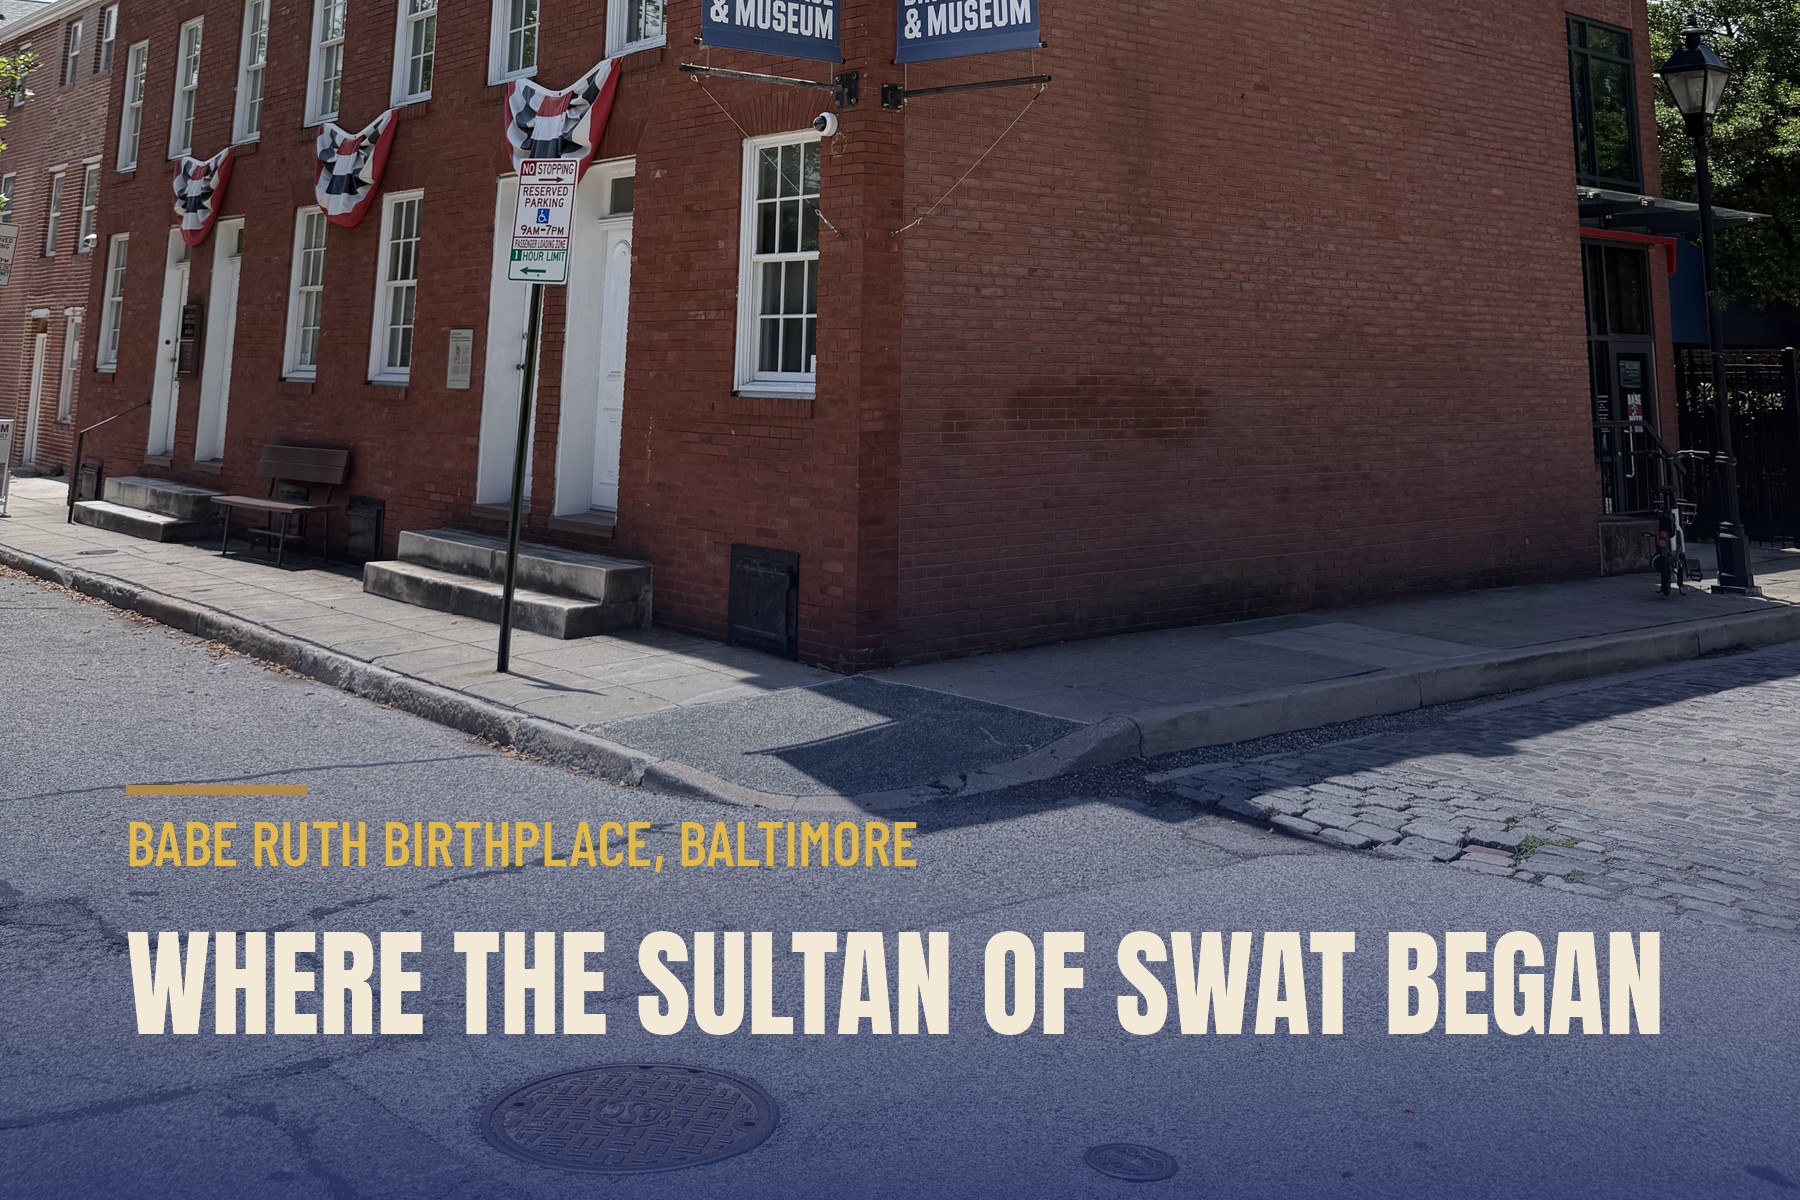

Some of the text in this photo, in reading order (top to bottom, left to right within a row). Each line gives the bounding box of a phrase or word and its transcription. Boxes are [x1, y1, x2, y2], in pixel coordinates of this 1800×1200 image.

[904, 8, 922, 39] &
[522, 163, 574, 175] NO STOPPING
[522, 186, 569, 197] RESERVED
[524, 197, 565, 208] PARKING
[520, 224, 565, 236] 9AM-7PM
[514, 239, 566, 249] PASSENGER LOADING ZONE
[514, 250, 566, 262] 1 HOUR LIMIT
